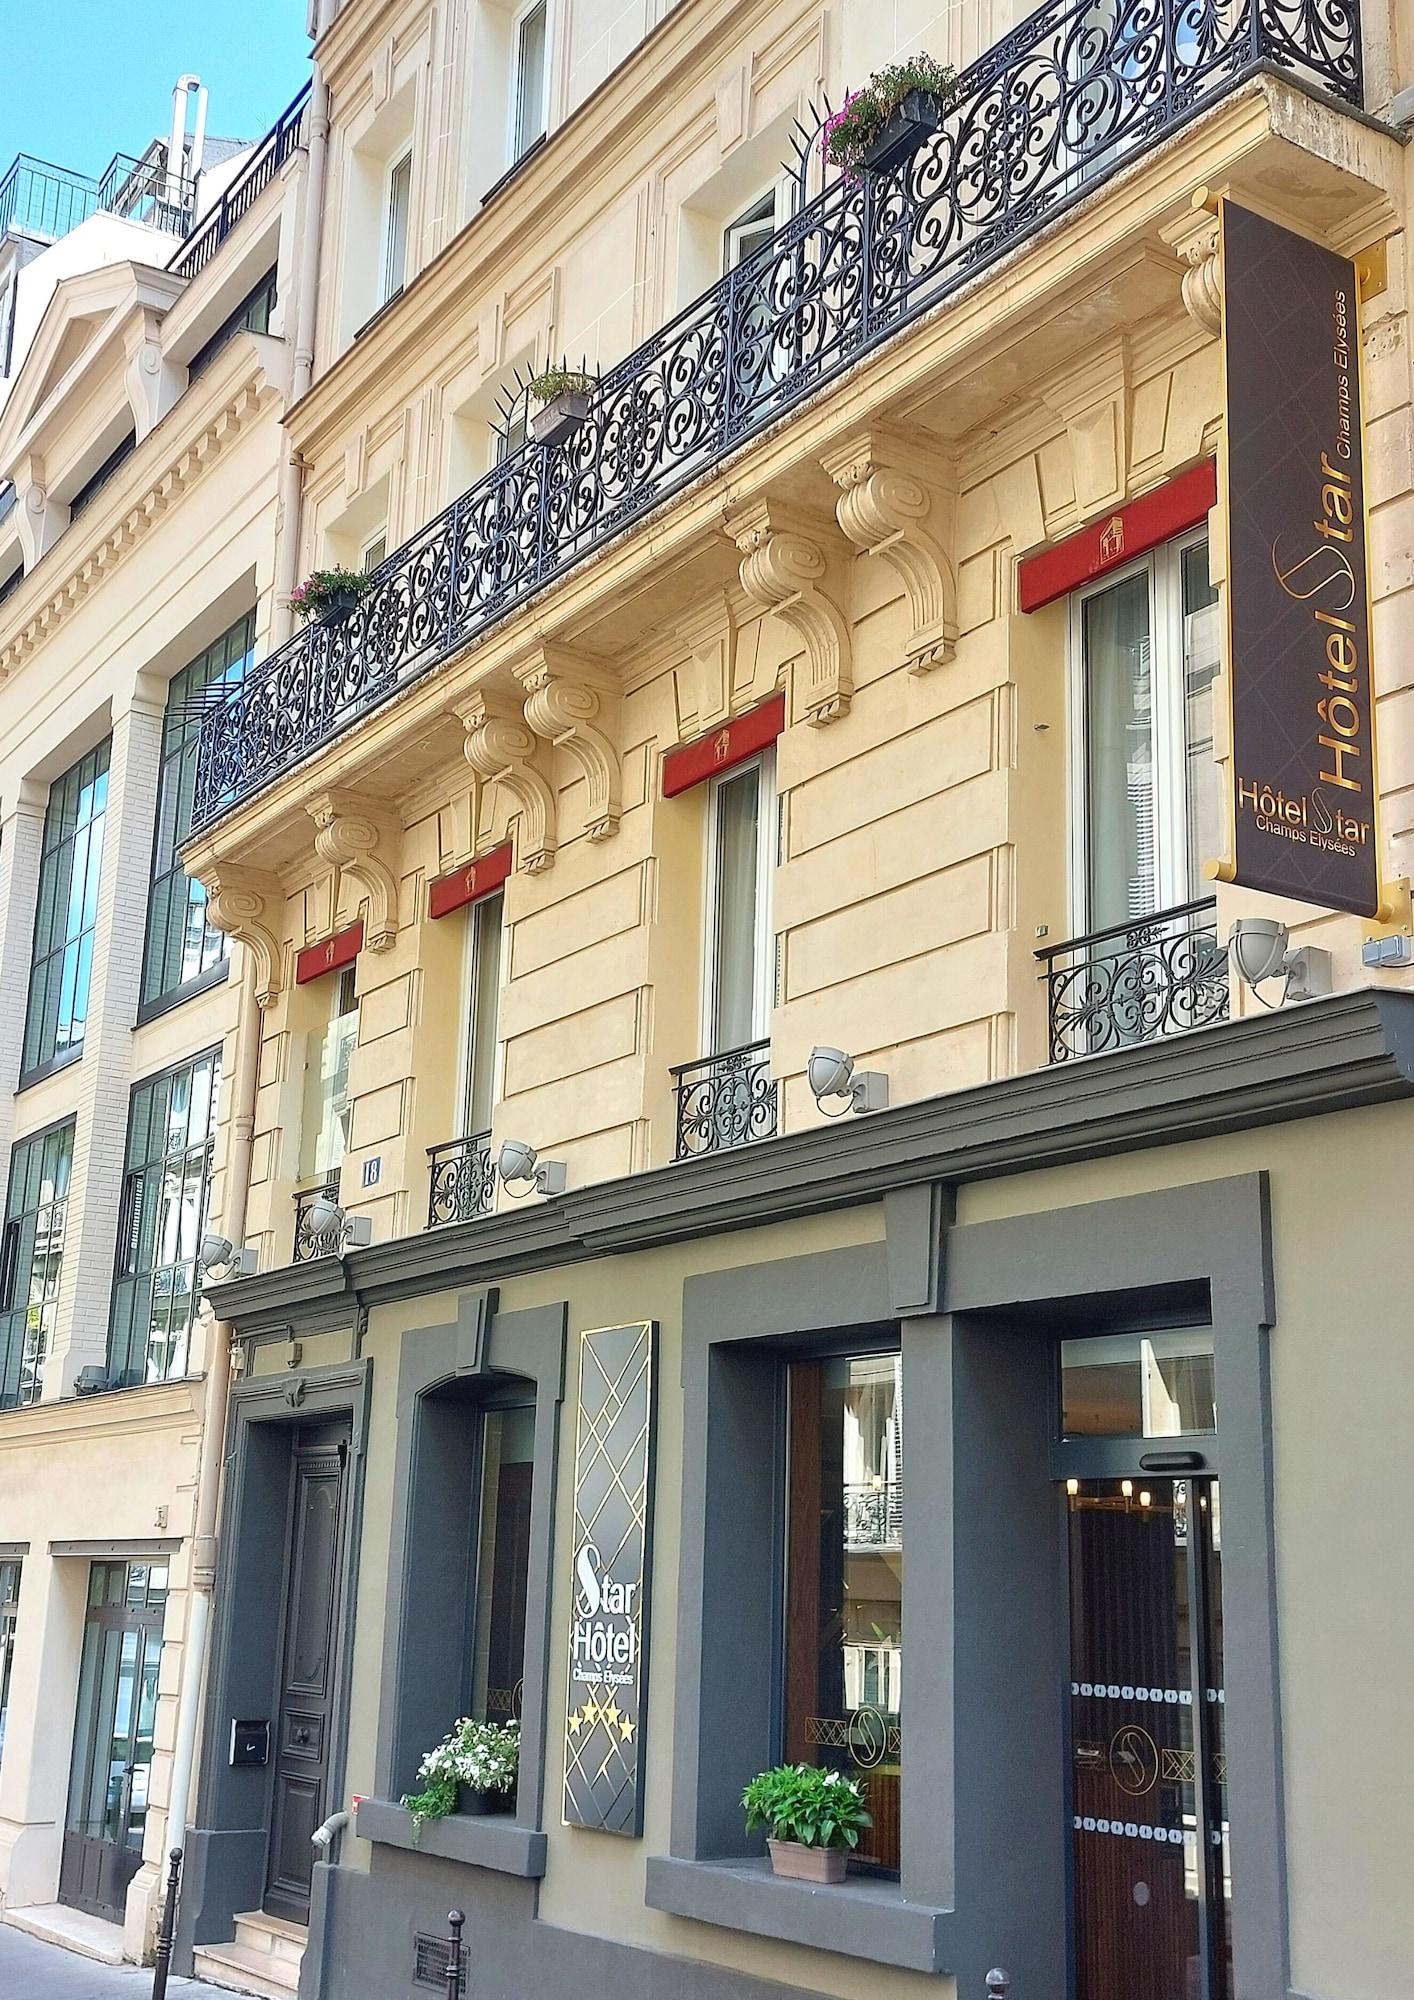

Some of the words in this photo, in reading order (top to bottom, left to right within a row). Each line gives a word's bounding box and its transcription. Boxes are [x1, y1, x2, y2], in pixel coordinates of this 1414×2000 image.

[1332, 290, 1351, 370] Elysées
[1336, 374, 1352, 459] Champs
[1272, 451, 1355, 611] Star
[1314, 610, 1362, 793] Hôtel
[1238, 776, 1307, 828] Hôtel
[1311, 786, 1370, 845] Star
[1255, 814, 1307, 843] Champs
[1309, 829, 1356, 857] Elysées
[364, 1160, 378, 1186] 18
[575, 1543, 637, 1619] Star
[572, 1621, 636, 1664] Hôtel
[572, 1667, 603, 1686] Champs
